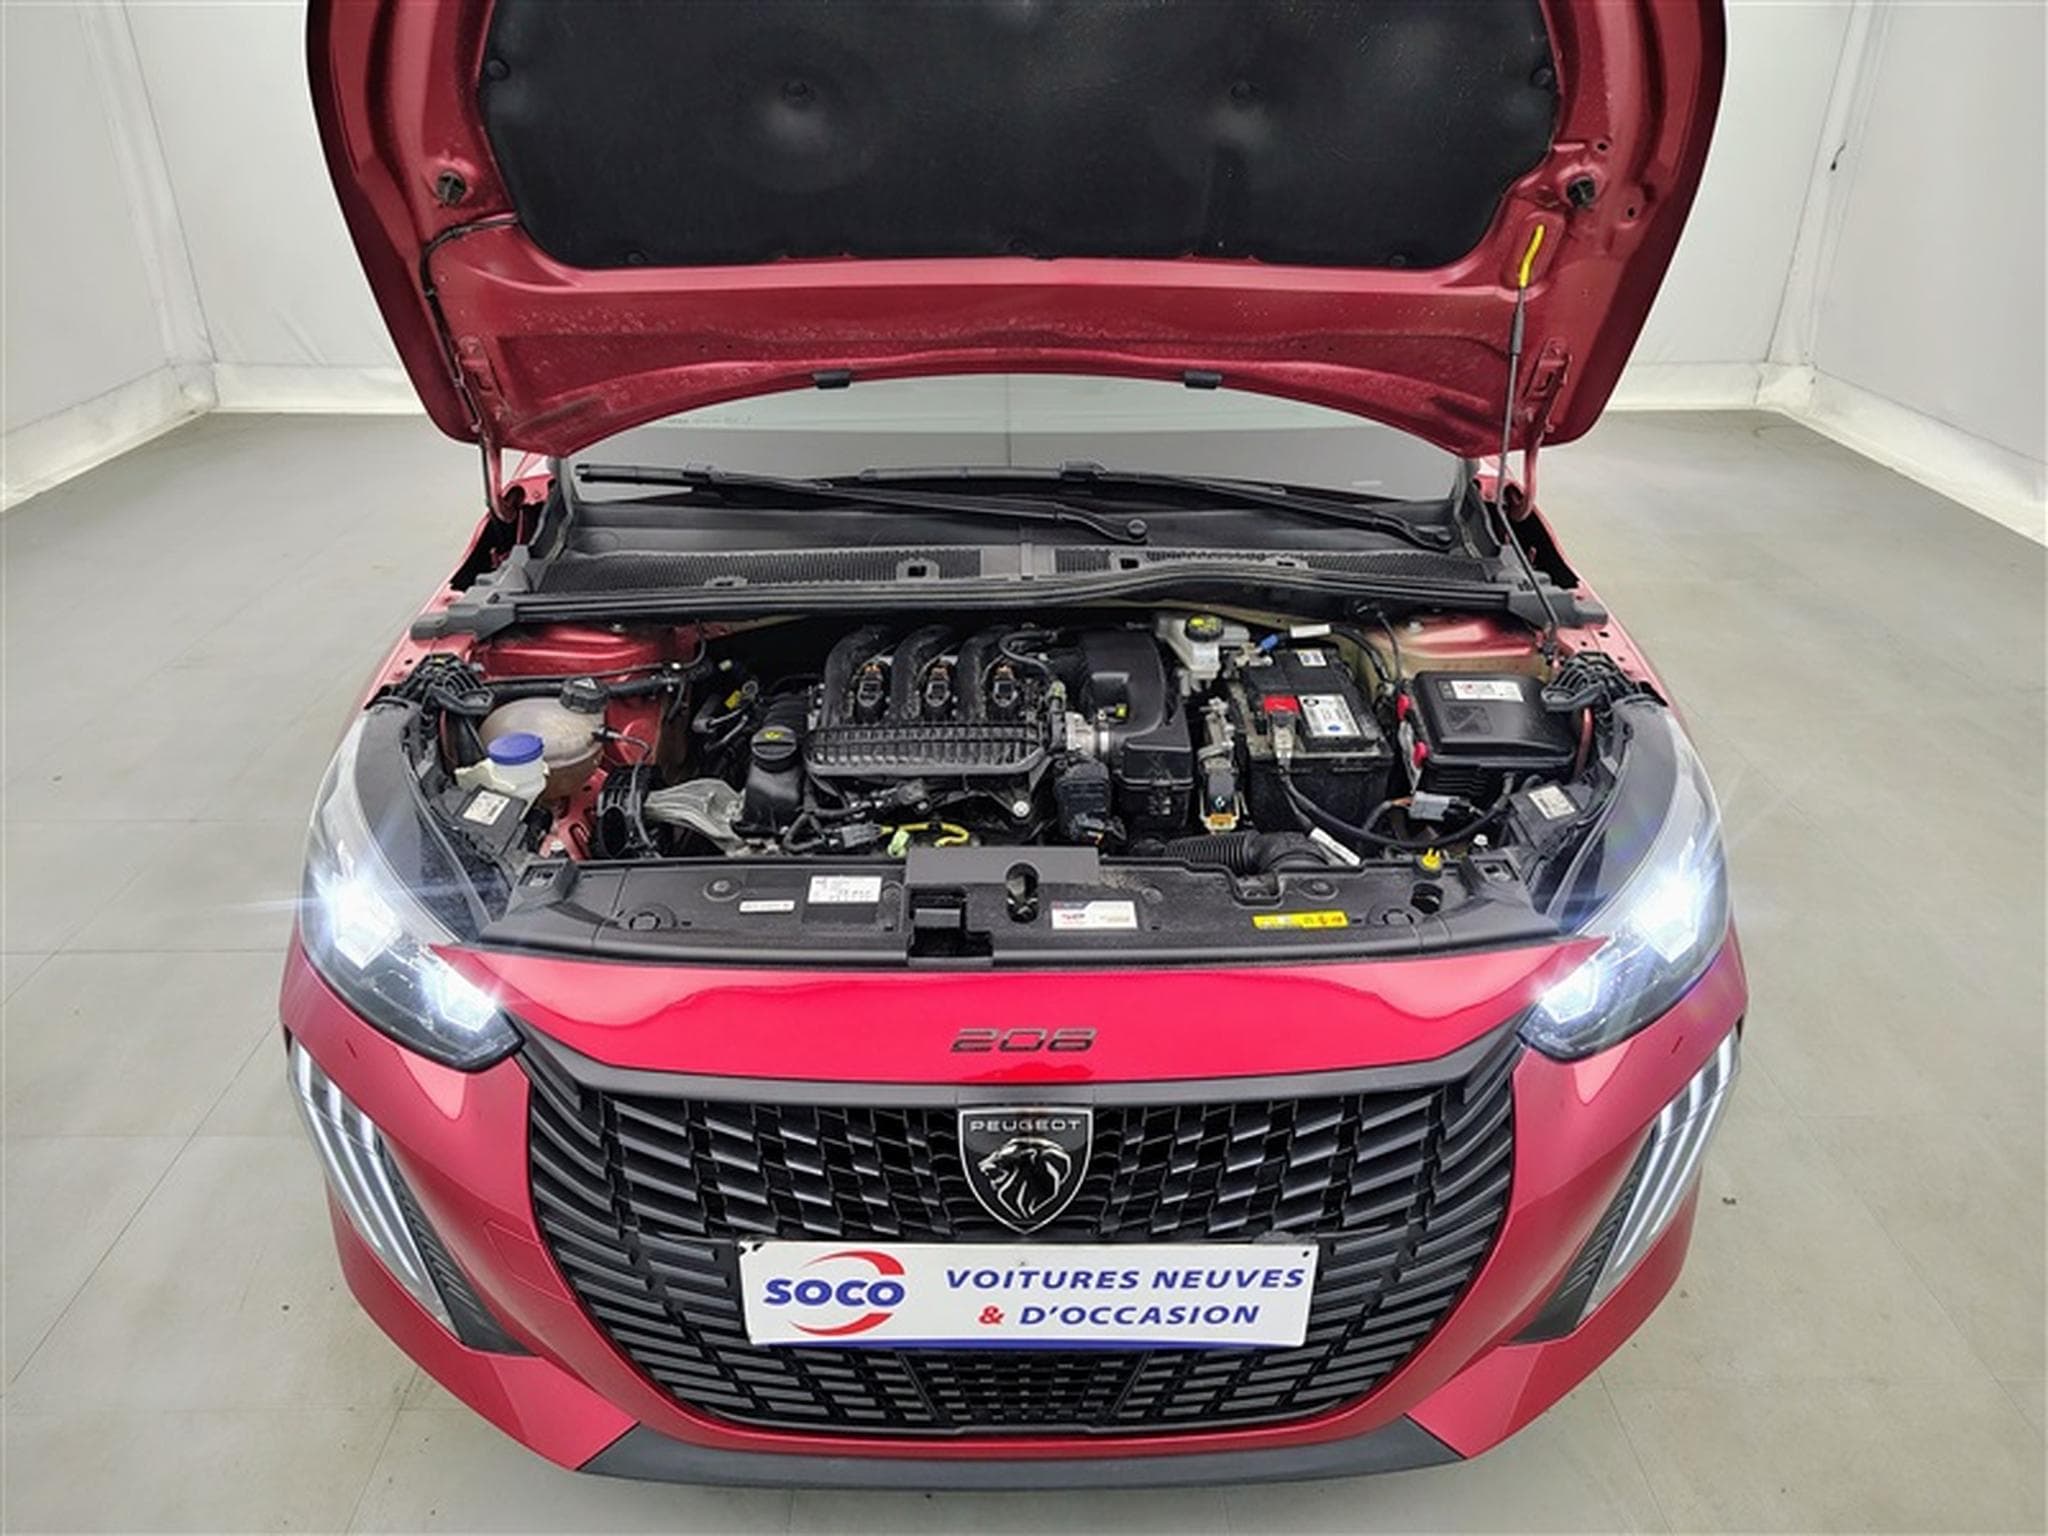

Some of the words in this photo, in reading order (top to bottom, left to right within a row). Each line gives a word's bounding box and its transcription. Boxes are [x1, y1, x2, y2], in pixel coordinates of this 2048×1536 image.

[952, 1027, 1098, 1052] 208
[969, 1119, 1082, 1132] PEUGEOT
[946, 1269, 1140, 1290] VOITURES
[1151, 1268, 1305, 1289] NEUVES
[763, 1278, 905, 1307] SOCO
[978, 1305, 1005, 1325] &
[1019, 1305, 1260, 1325] D'OCCASION
